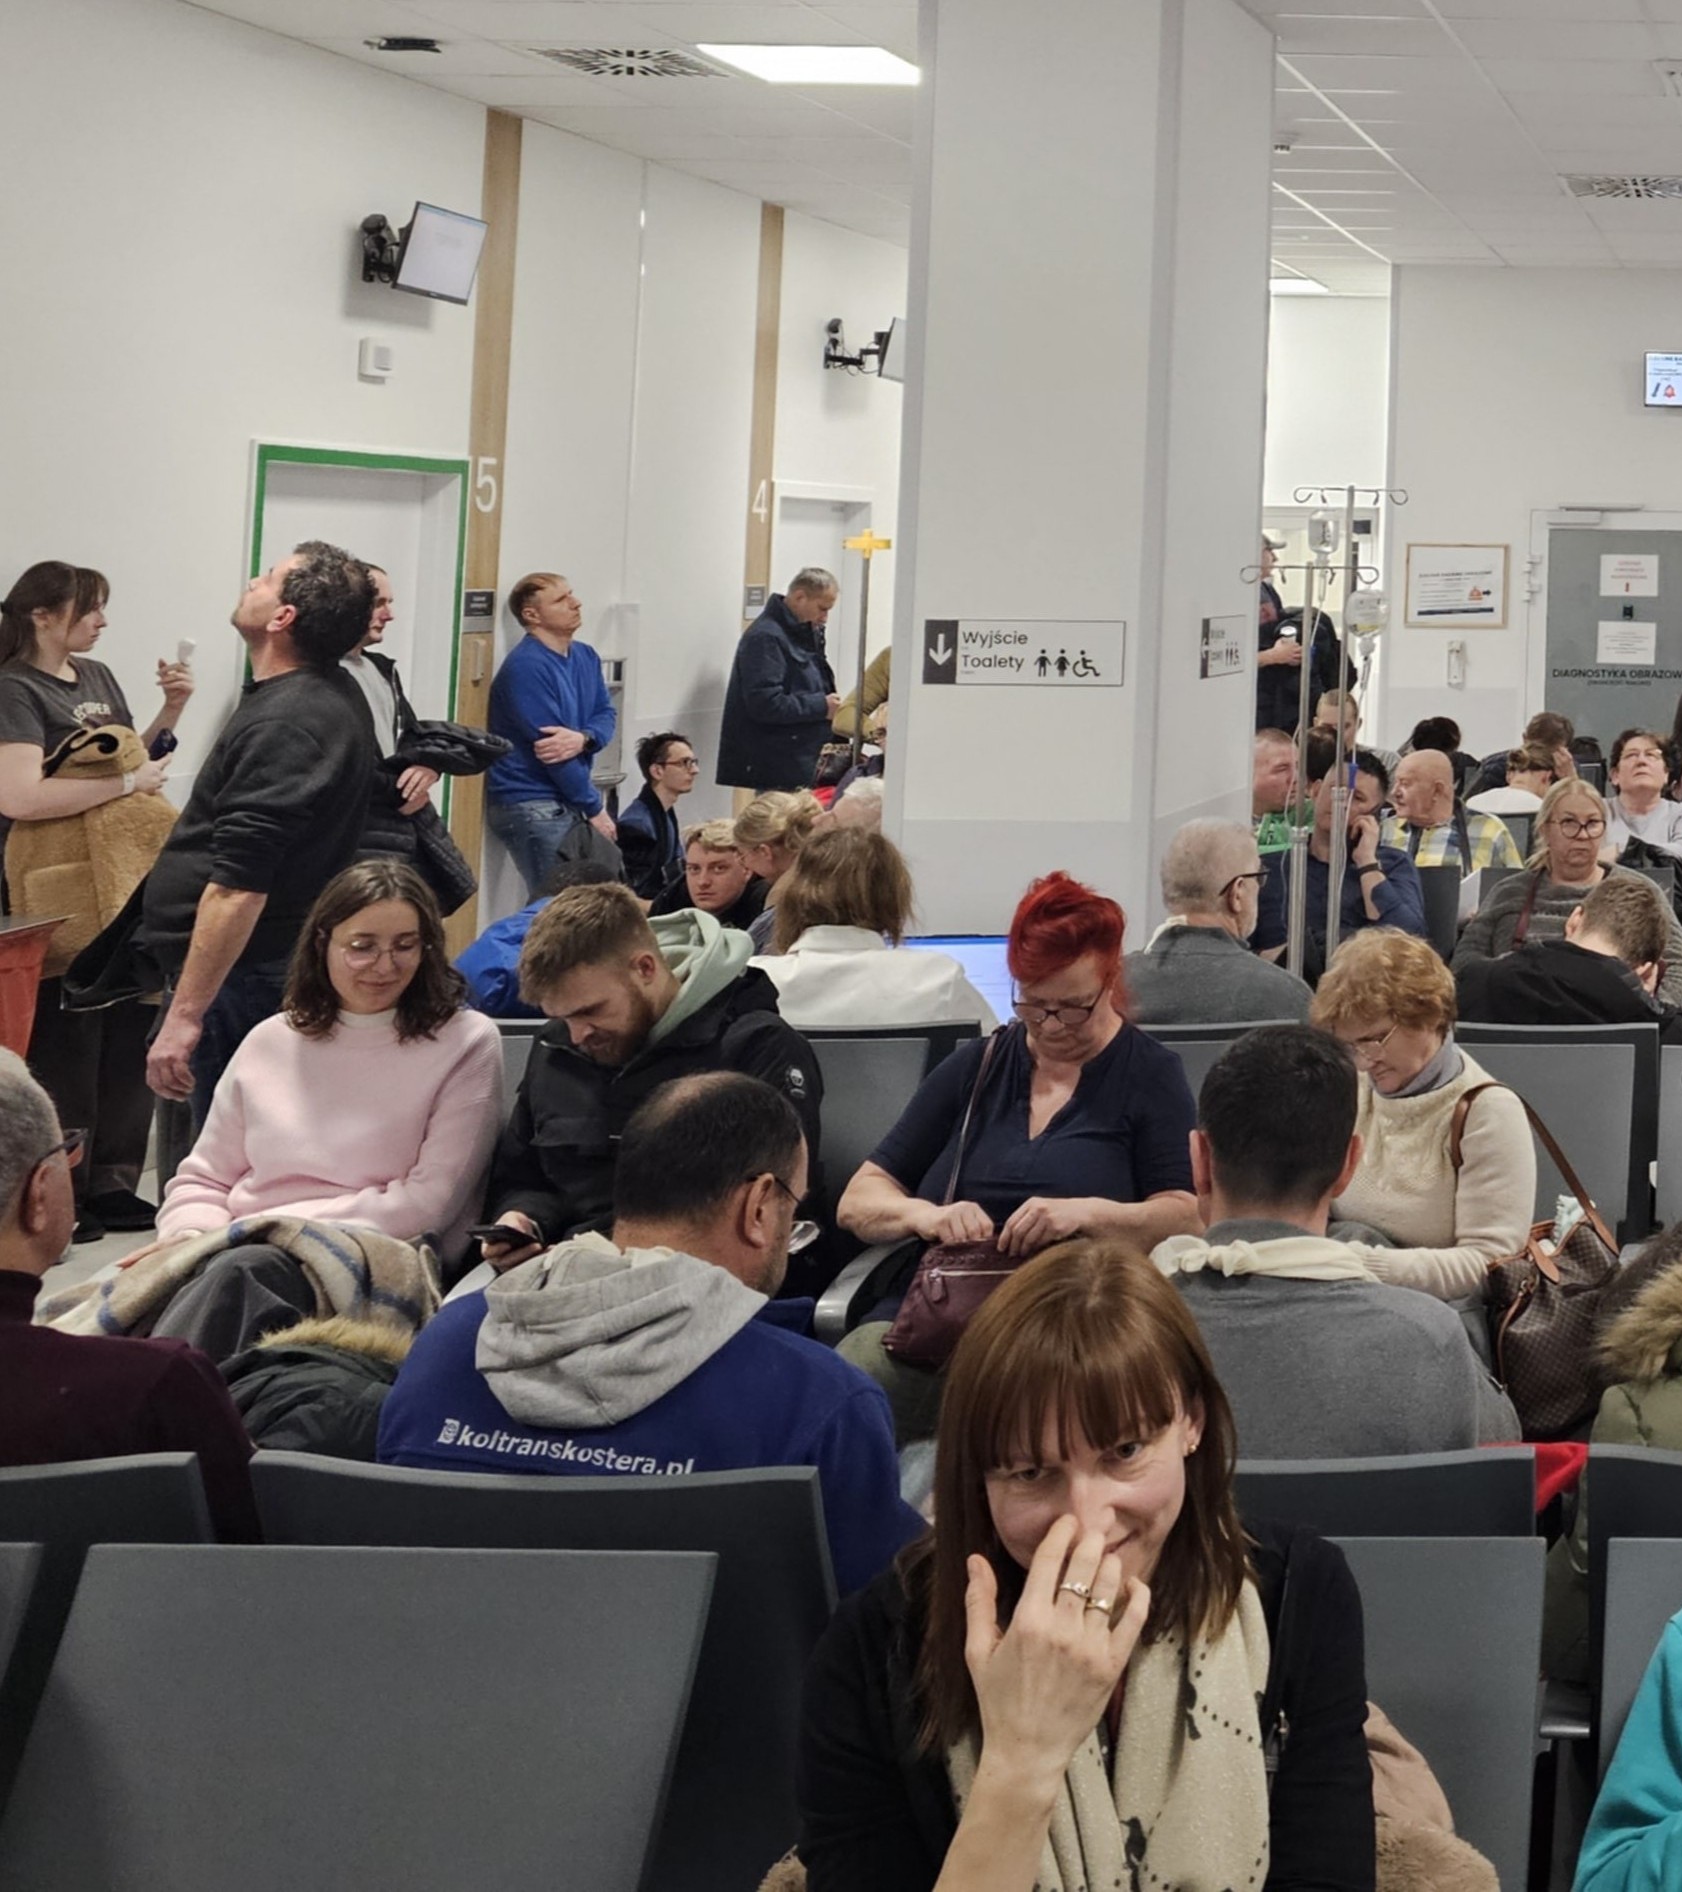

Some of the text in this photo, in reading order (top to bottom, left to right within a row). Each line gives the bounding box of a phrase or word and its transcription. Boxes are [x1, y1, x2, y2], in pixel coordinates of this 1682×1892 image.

[475, 456, 497, 513] 5
[752, 479, 768, 523] 4
[962, 630, 1028, 649] Wyjście
[961, 654, 1024, 673] Toalety
[1552, 669, 1627, 679] DIAGNOSTYKA
[456, 1424, 695, 1475] koltranskostera.pl
